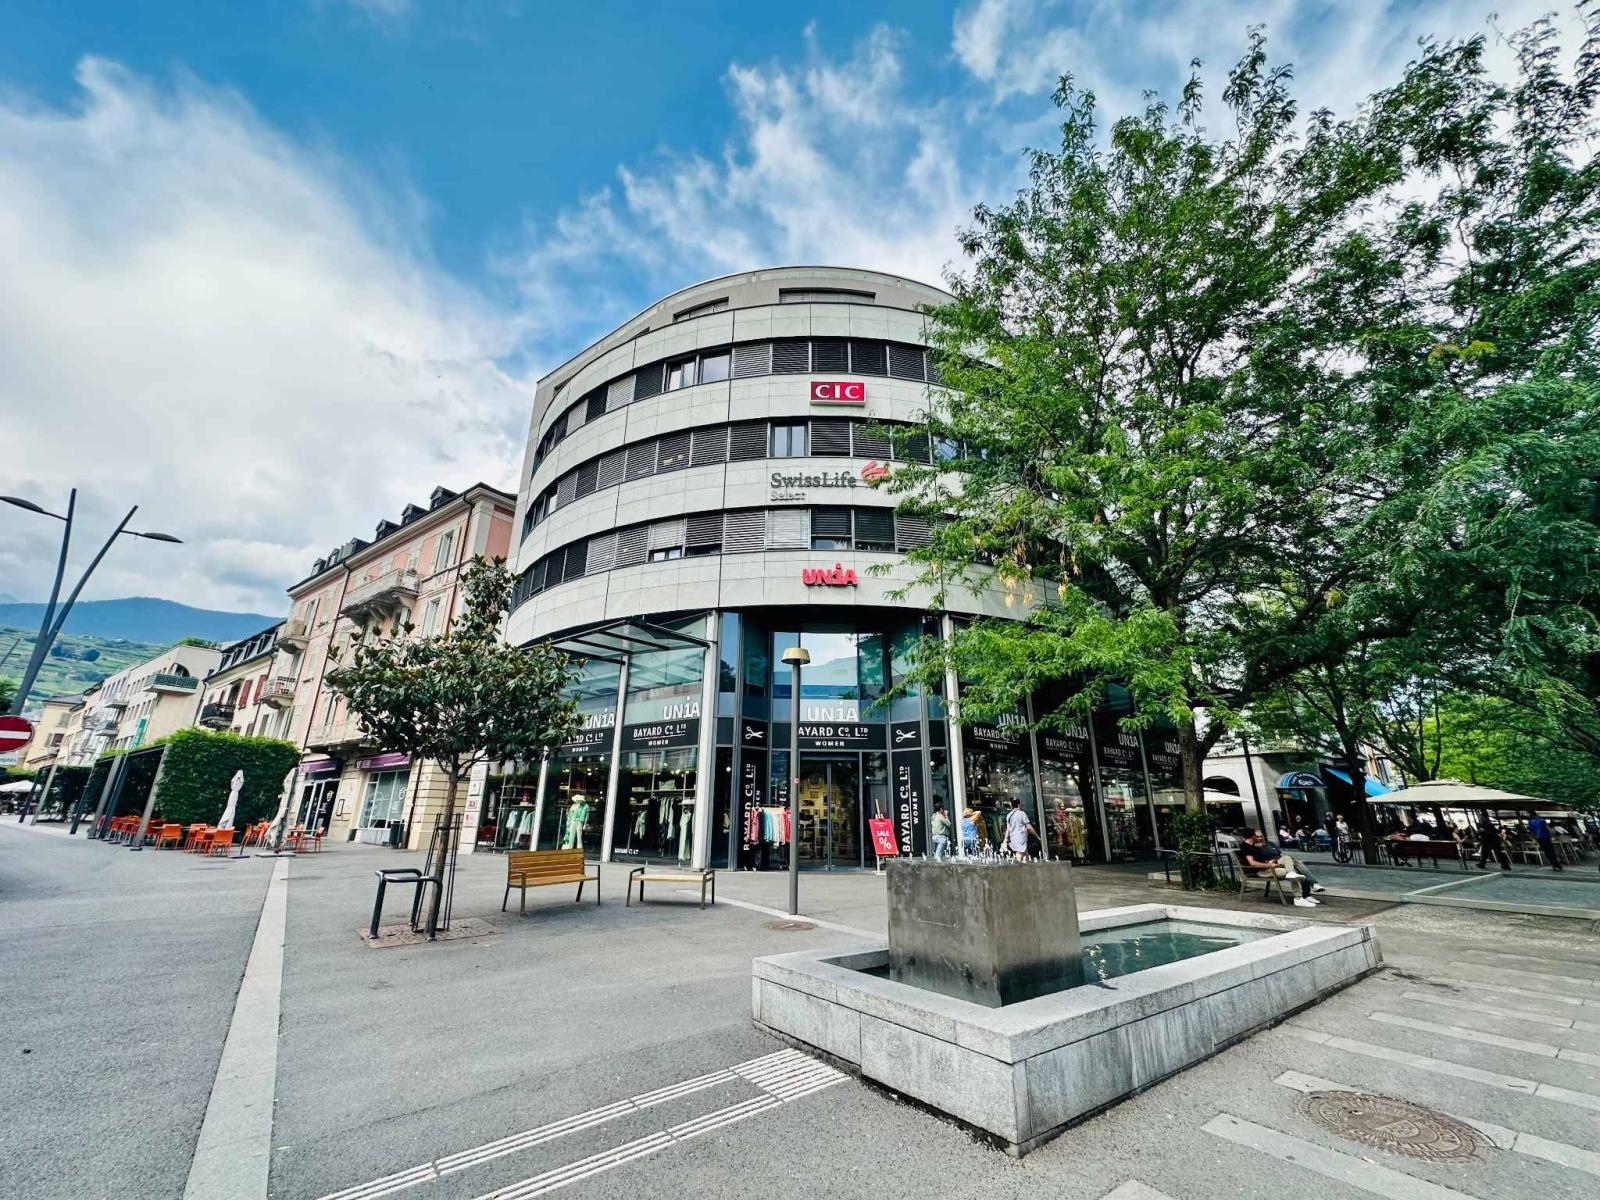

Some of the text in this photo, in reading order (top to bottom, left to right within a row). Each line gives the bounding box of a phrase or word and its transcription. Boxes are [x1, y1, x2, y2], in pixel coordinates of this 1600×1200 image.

[815, 384, 859, 399] CIC
[770, 470, 857, 488] SwissLife
[633, 726, 662, 738] BAYARD
[798, 726, 834, 736] AYARD
[973, 726, 1000, 739] BAYARD
[901, 803, 911, 852] BAYARD
